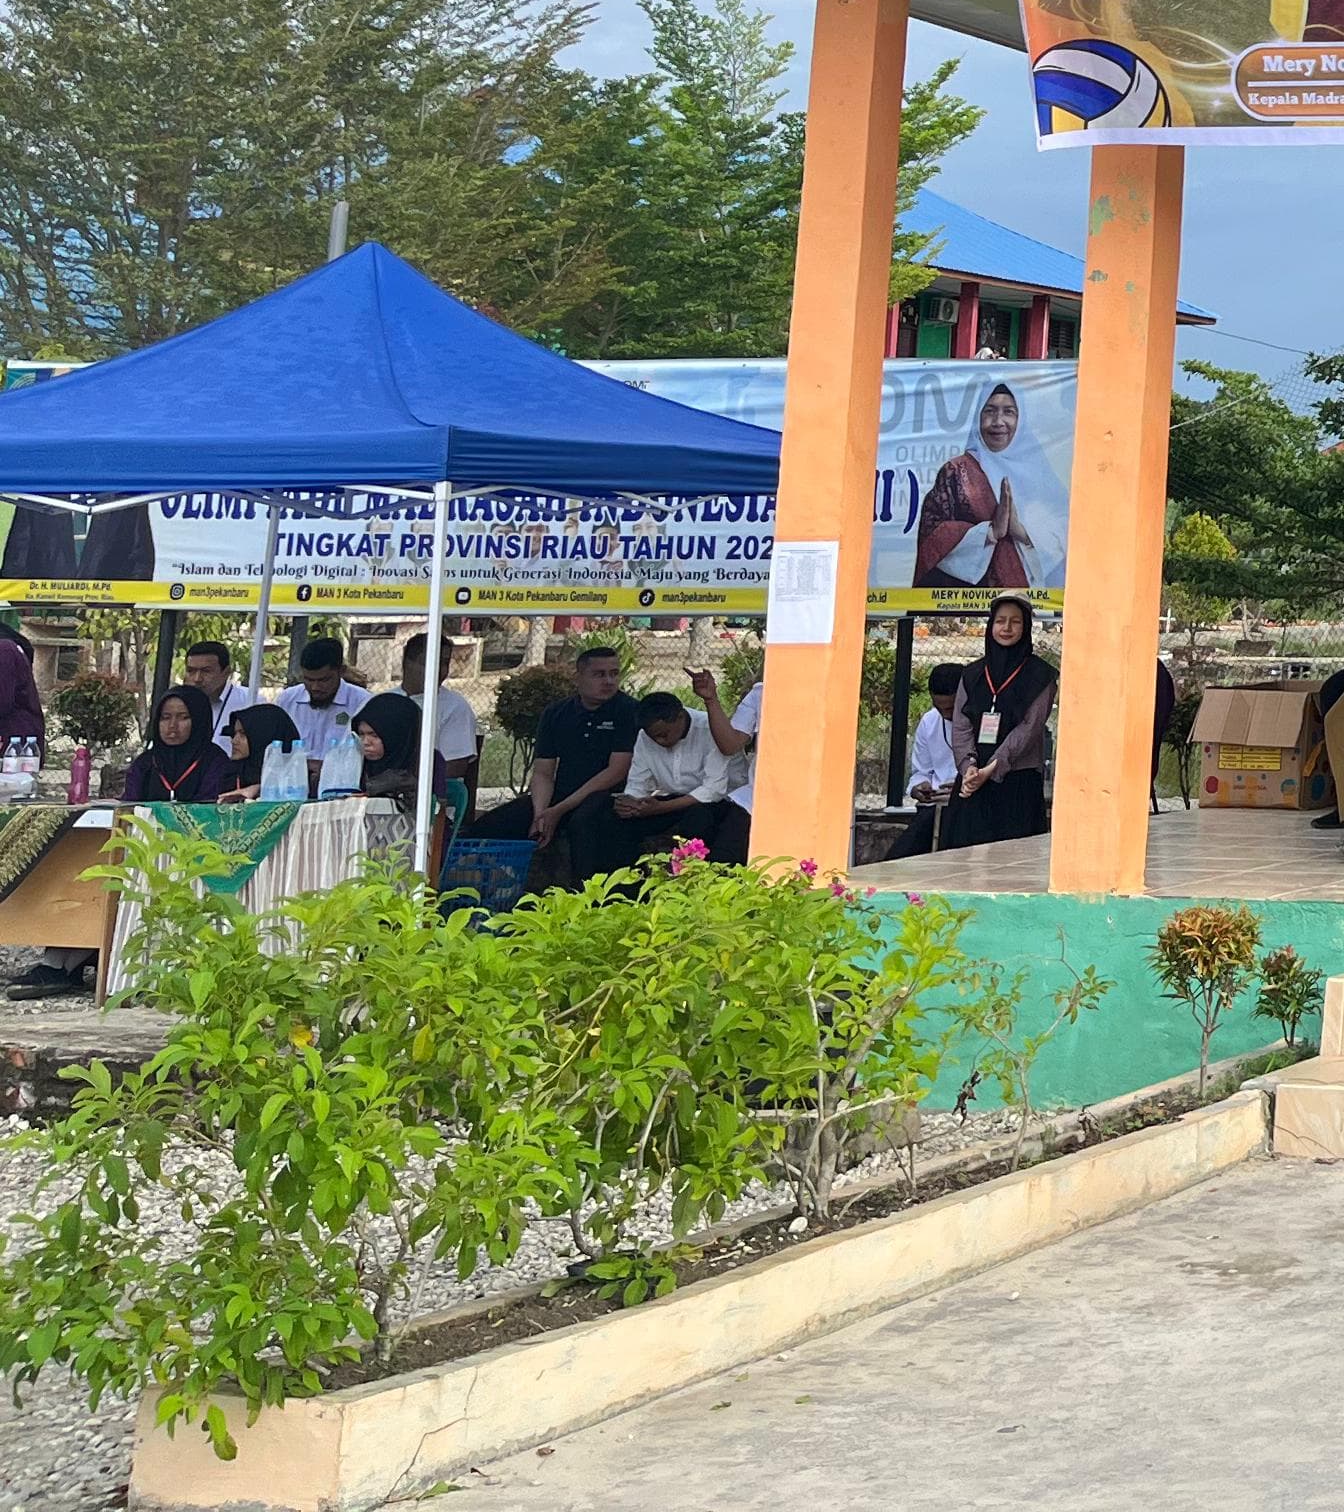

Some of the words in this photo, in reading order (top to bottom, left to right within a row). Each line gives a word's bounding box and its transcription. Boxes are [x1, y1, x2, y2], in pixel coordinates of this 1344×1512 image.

[1262, 55, 1316, 76] Mery
[1248, 92, 1299, 107] Kepala
[272, 533, 391, 557] TINGKAT
[541, 535, 609, 560] RIAU
[618, 535, 716, 560] TAHUN
[316, 588, 335, 598] MAN
[343, 589, 361, 599] Kota
[363, 589, 404, 600] Pekanbaru
[478, 591, 497, 601] MAN
[506, 591, 524, 601] Kota
[526, 591, 568, 602] Pekanbaru
[931, 590, 960, 600] MERY
